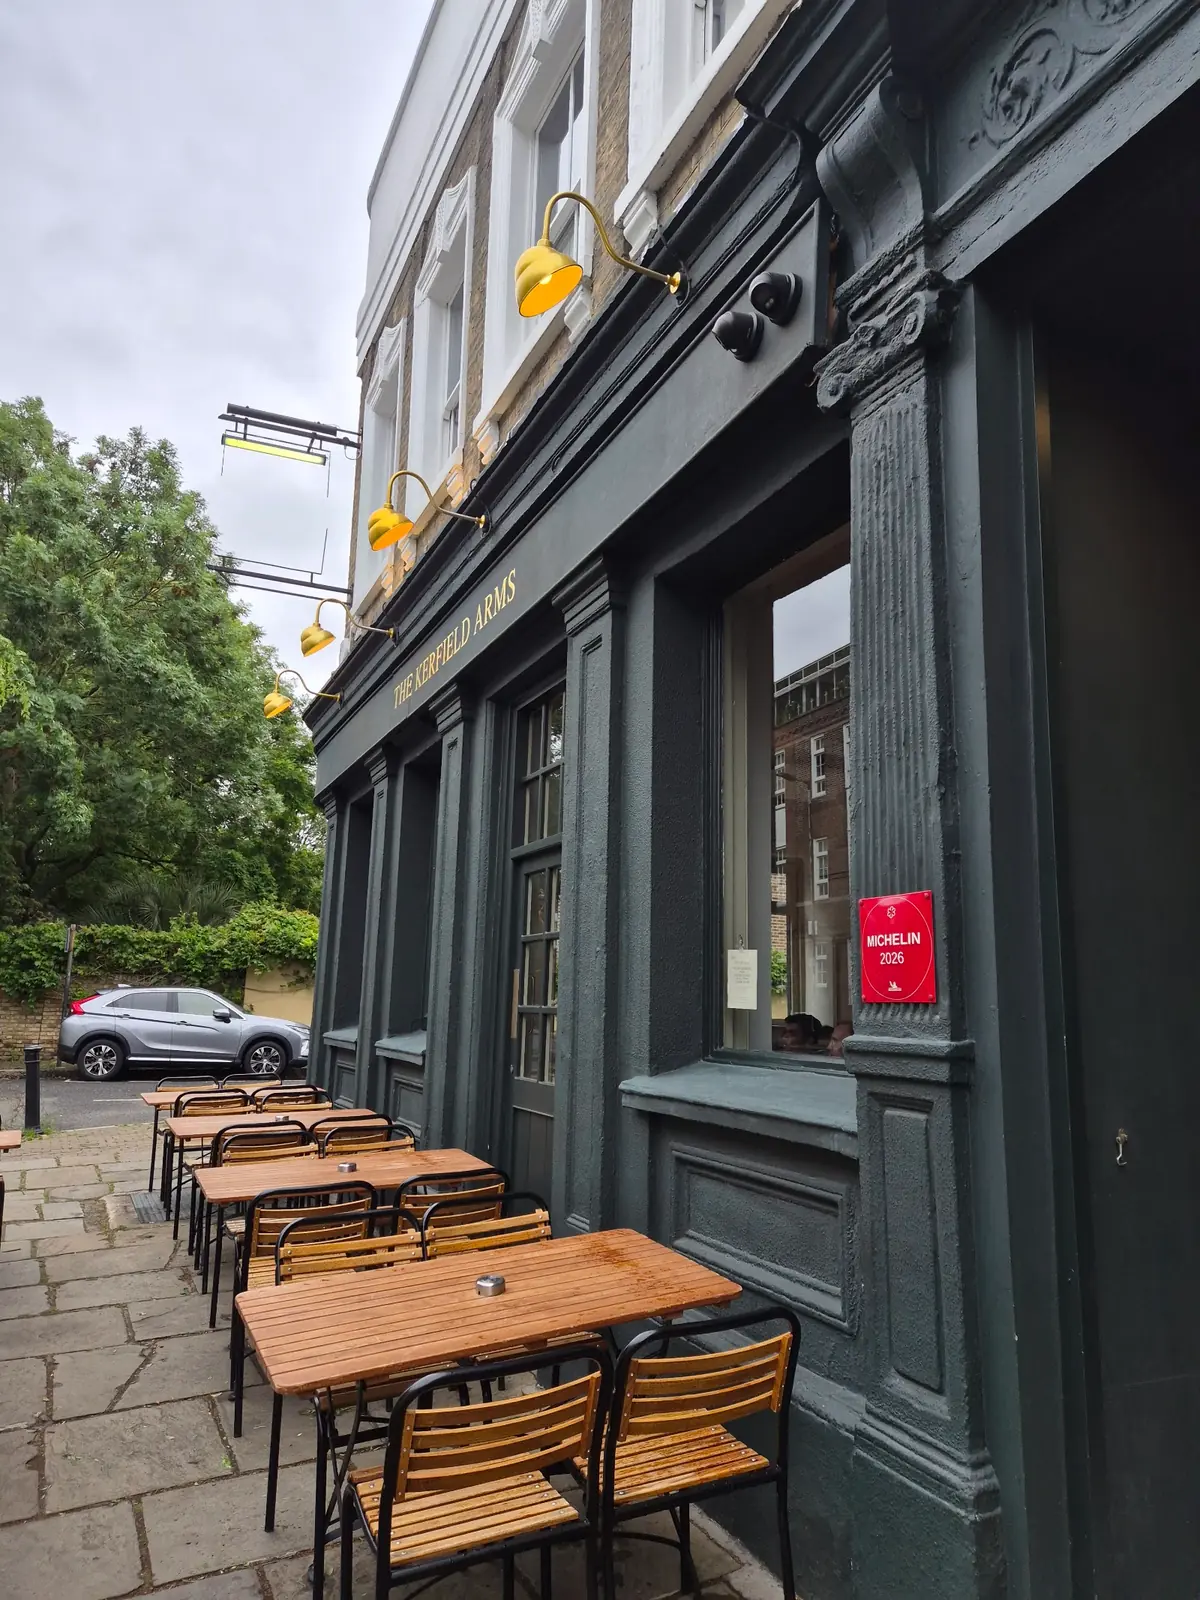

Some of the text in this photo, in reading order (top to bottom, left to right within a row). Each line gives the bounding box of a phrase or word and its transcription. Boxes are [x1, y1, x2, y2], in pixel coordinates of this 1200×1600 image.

[393, 568, 516, 709] THE KERFIELD ARMS
[867, 932, 921, 948] MICHELIN
[879, 951, 905, 965] 2026
